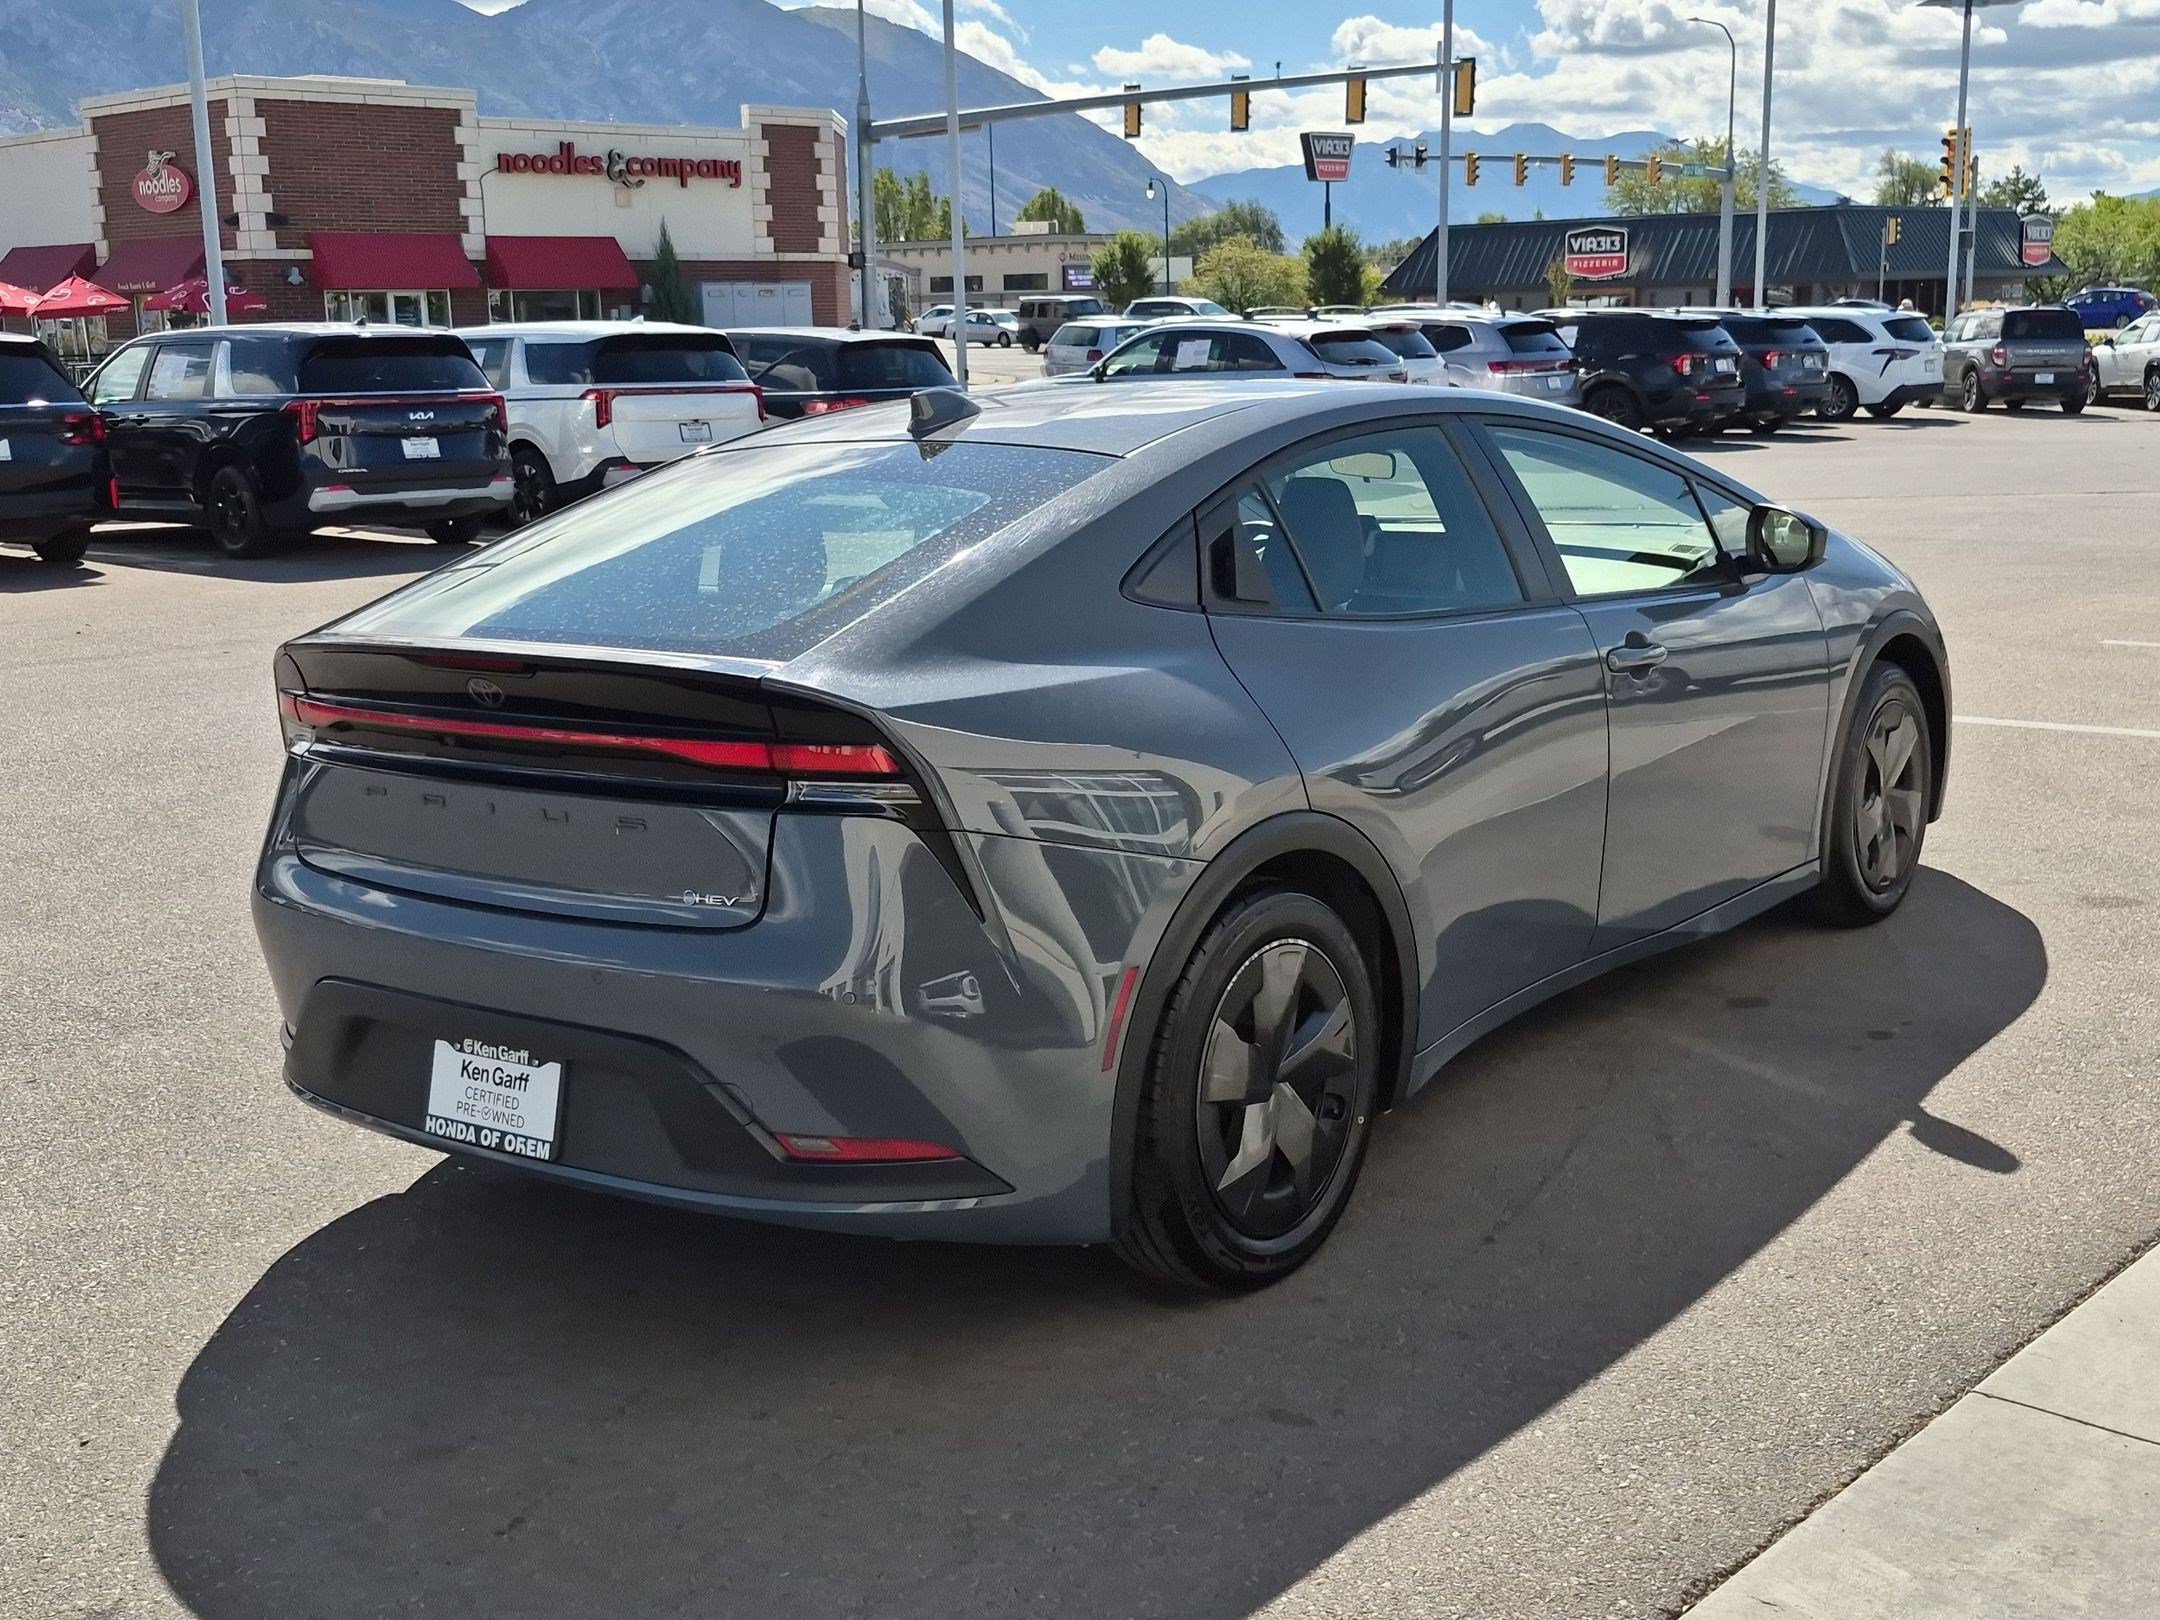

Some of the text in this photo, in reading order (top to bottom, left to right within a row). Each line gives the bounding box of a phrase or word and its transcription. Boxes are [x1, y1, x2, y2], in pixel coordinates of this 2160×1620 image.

[497, 141, 604, 175] noodles
[626, 156, 742, 188] company
[138, 169, 182, 196] noodles
[1572, 258, 1618, 268] PIZZERIA
[695, 894, 740, 907] HEV
[473, 1040, 530, 1065] Ken Garff
[461, 1059, 530, 1092] Ken Garff
[465, 1086, 520, 1110] CERTIFIED
[425, 1115, 551, 1160] HONDA OF OREM
